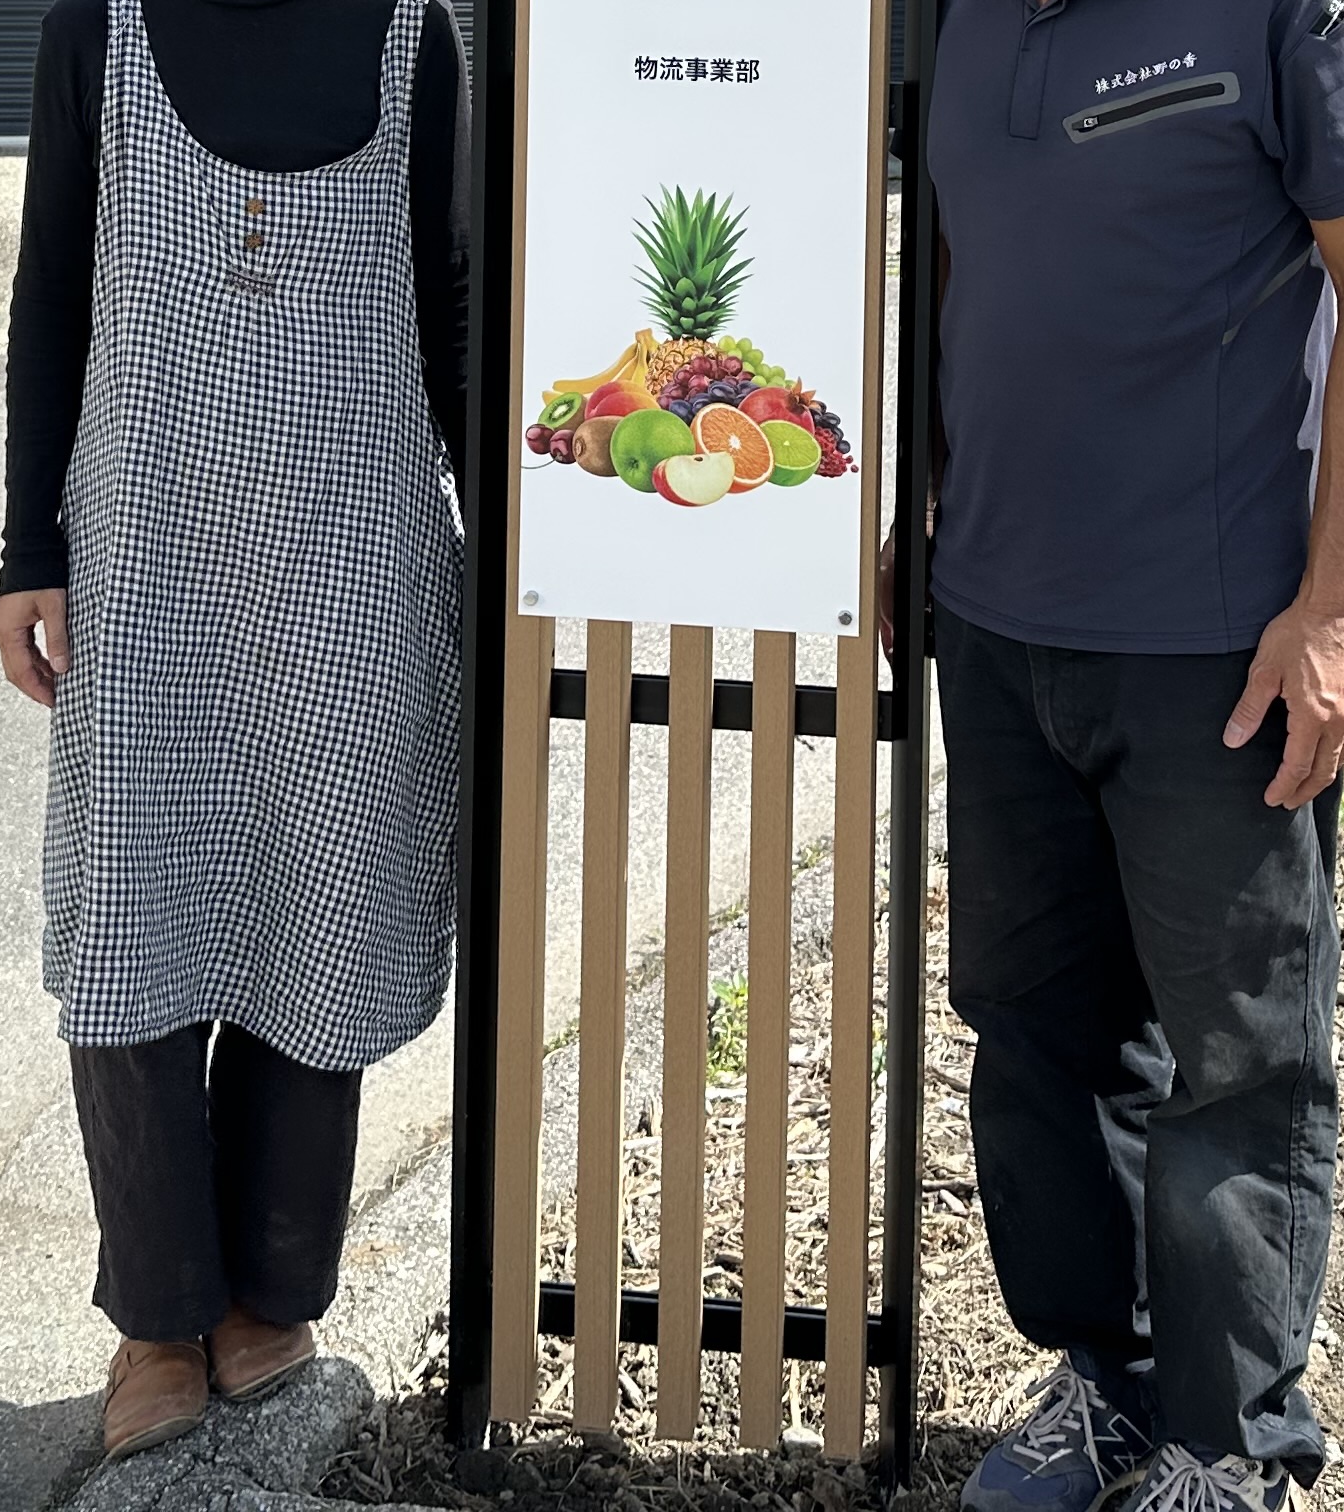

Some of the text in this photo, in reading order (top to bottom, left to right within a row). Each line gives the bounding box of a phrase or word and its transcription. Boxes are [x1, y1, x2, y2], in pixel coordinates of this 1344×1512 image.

[634, 55, 760, 84] 物流事業部
[1094, 51, 1198, 95] 株式会社野の香
